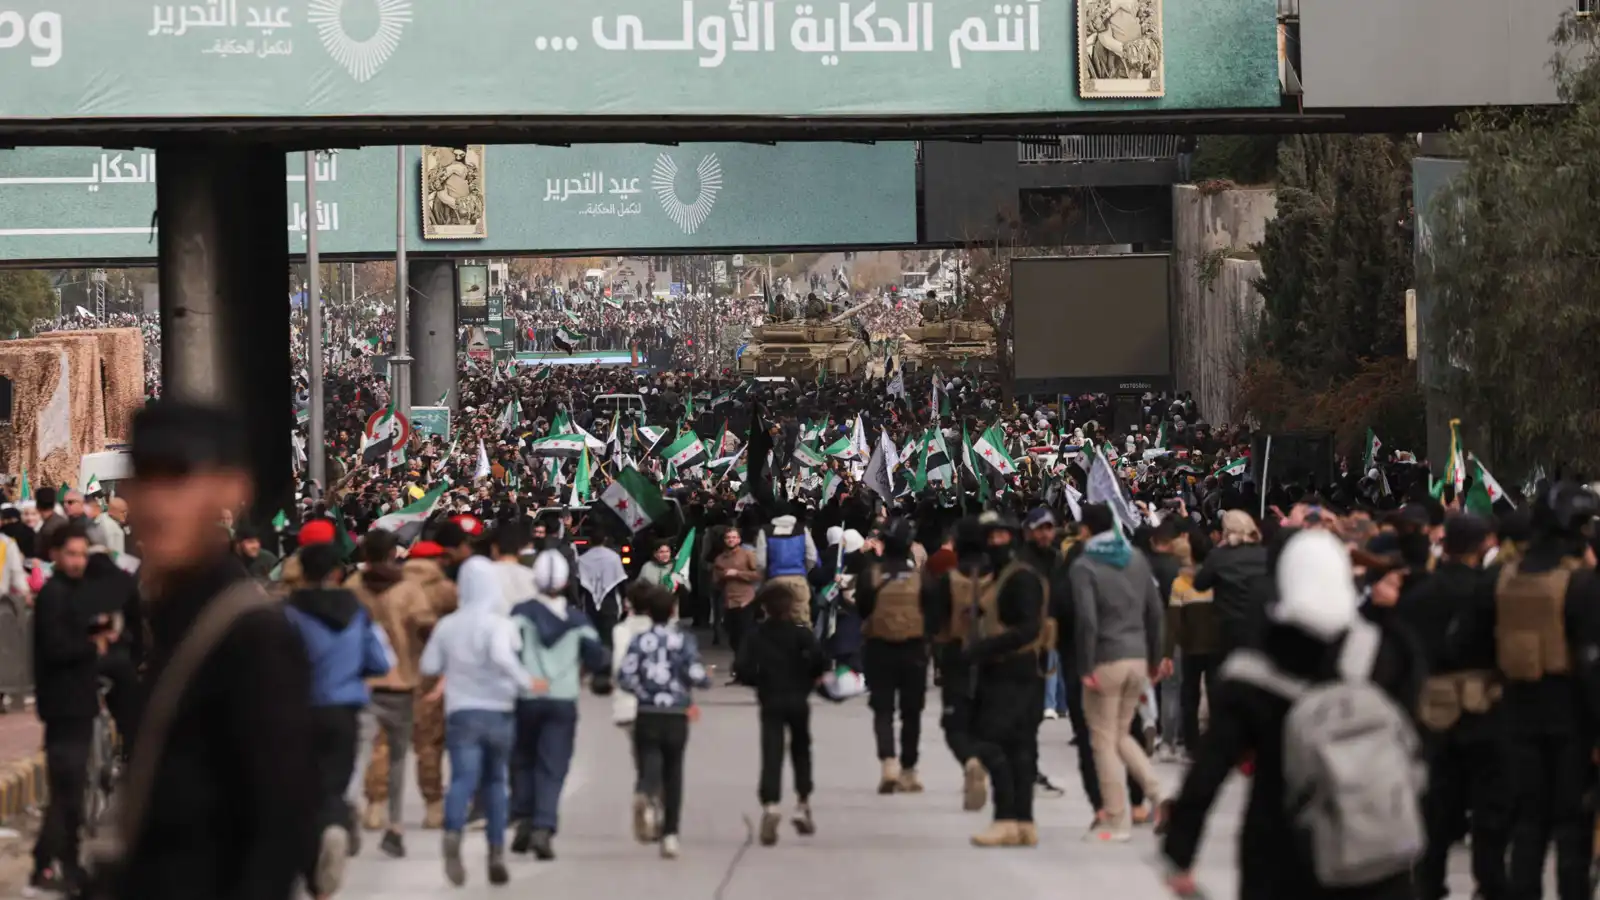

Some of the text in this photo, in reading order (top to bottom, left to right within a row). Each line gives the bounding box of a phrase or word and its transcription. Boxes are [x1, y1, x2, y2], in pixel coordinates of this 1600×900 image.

[148, 0, 292, 36] عيد التحرير
[592, 0, 775, 67] الأولى
[790, 1, 933, 66] الحكاية
[949, 0, 1040, 68] أنتم
[543, 170, 642, 202] عيد التحرير
[617, 203, 641, 216] لنكمل
